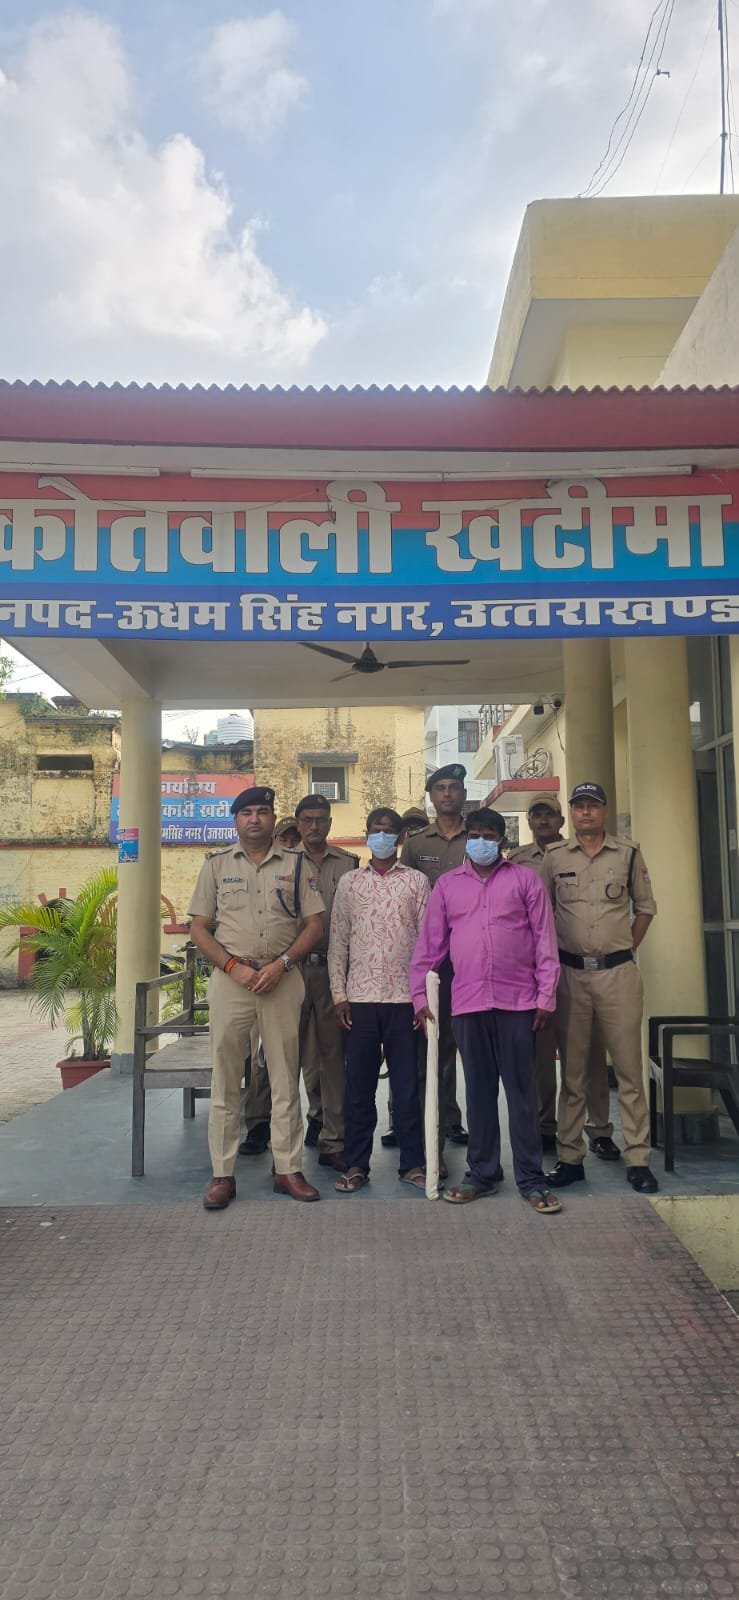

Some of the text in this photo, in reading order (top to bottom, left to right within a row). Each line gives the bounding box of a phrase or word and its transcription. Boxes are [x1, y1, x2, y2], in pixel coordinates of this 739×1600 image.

[0, 475, 733, 574] कोतवाली खटीमा
[240, 593, 328, 631] सिंह
[334, 601, 444, 638] नगर,
[200, 801, 232, 818] खटी
